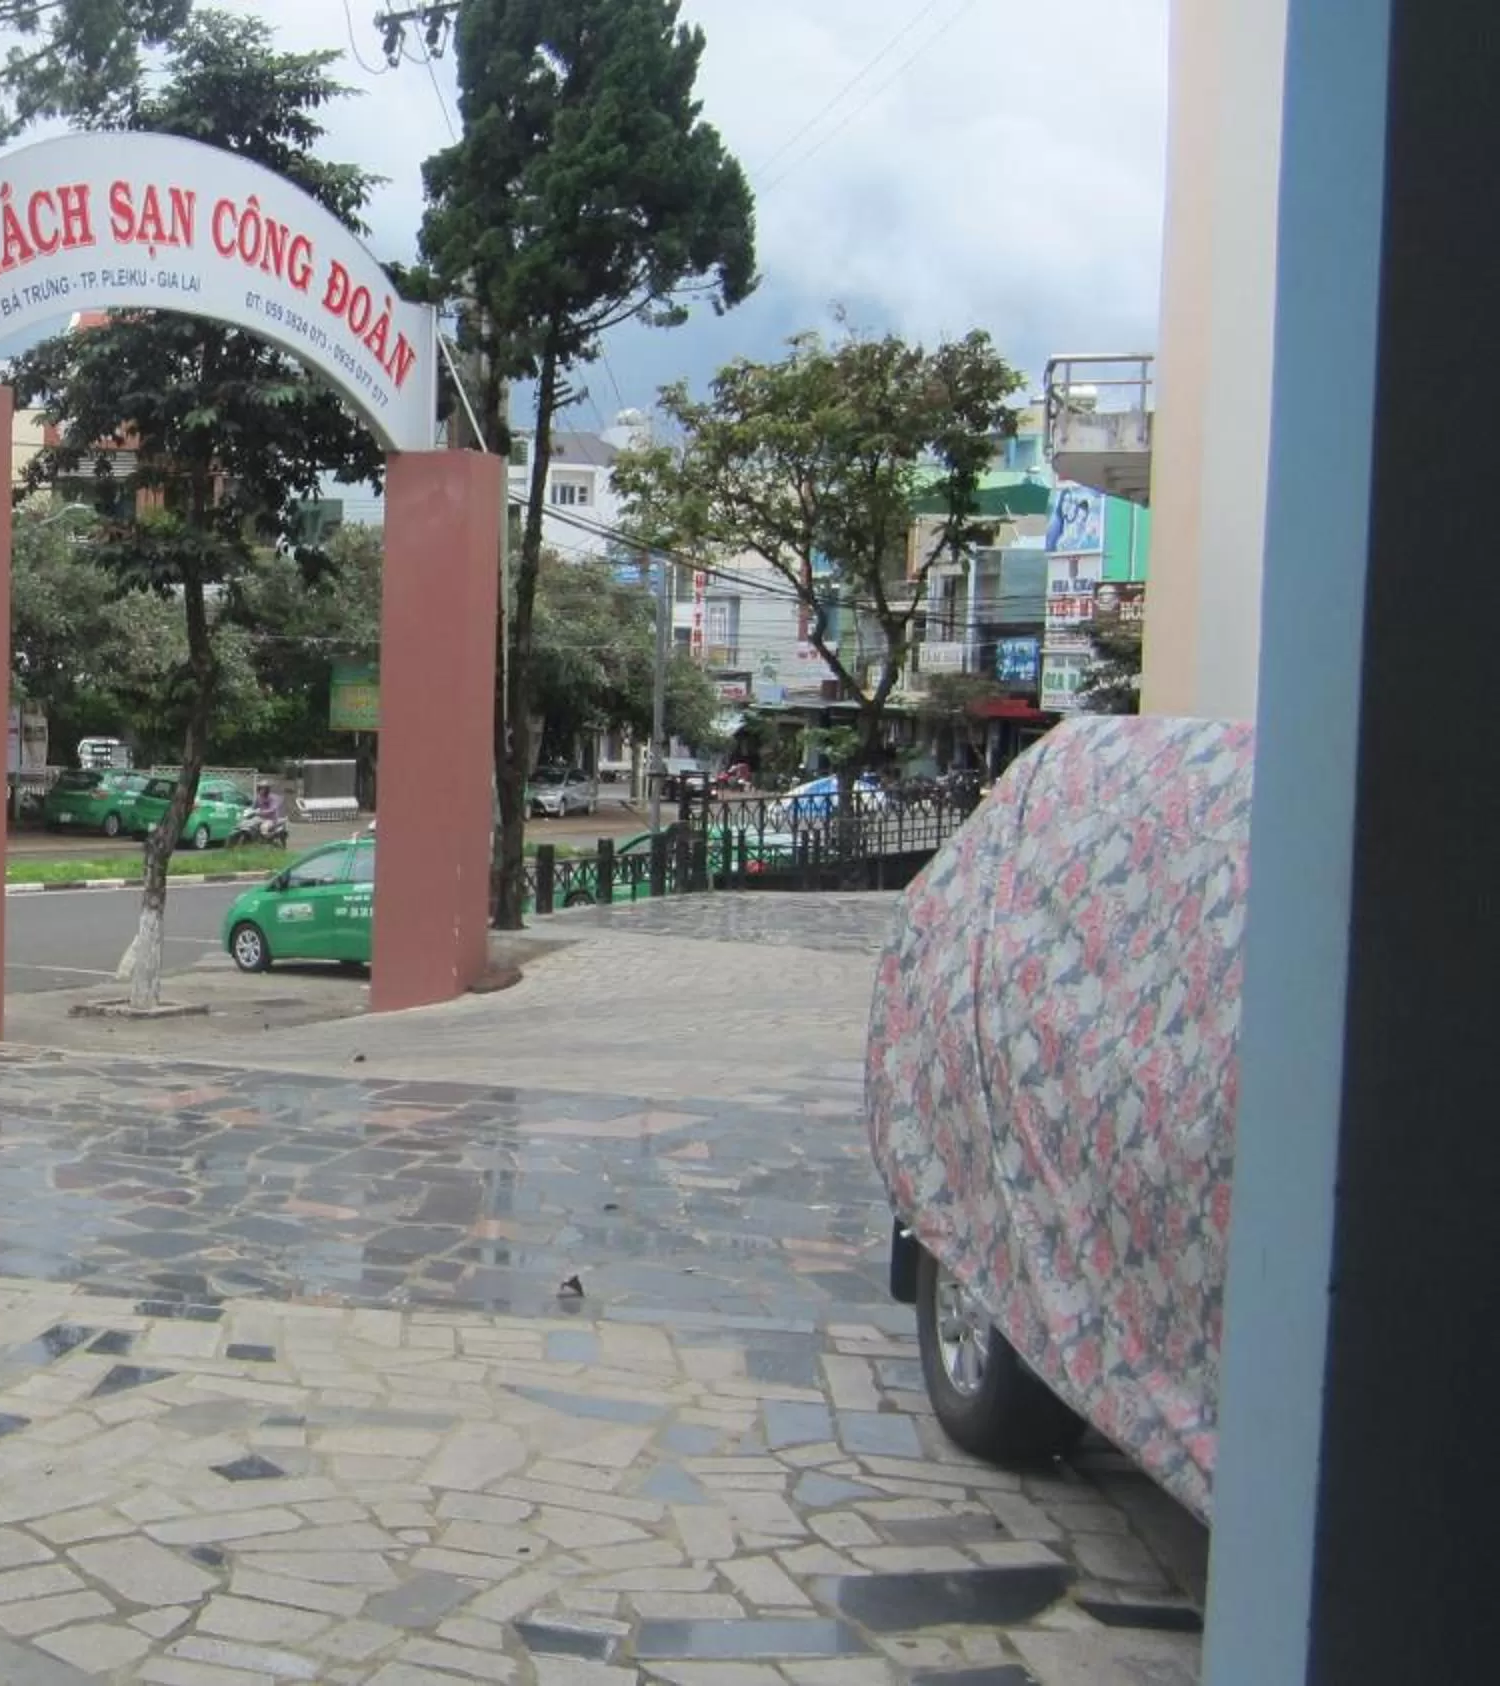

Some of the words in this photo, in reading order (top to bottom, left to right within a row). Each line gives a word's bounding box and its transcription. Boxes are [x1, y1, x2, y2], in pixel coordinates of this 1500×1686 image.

[101, 268, 148, 288] PLEIKU
[157, 270, 180, 289] GIA
[108, 179, 196, 261] SẠN
[211, 193, 315, 296] CÔNG
[321, 257, 417, 391] ĐOÀN
